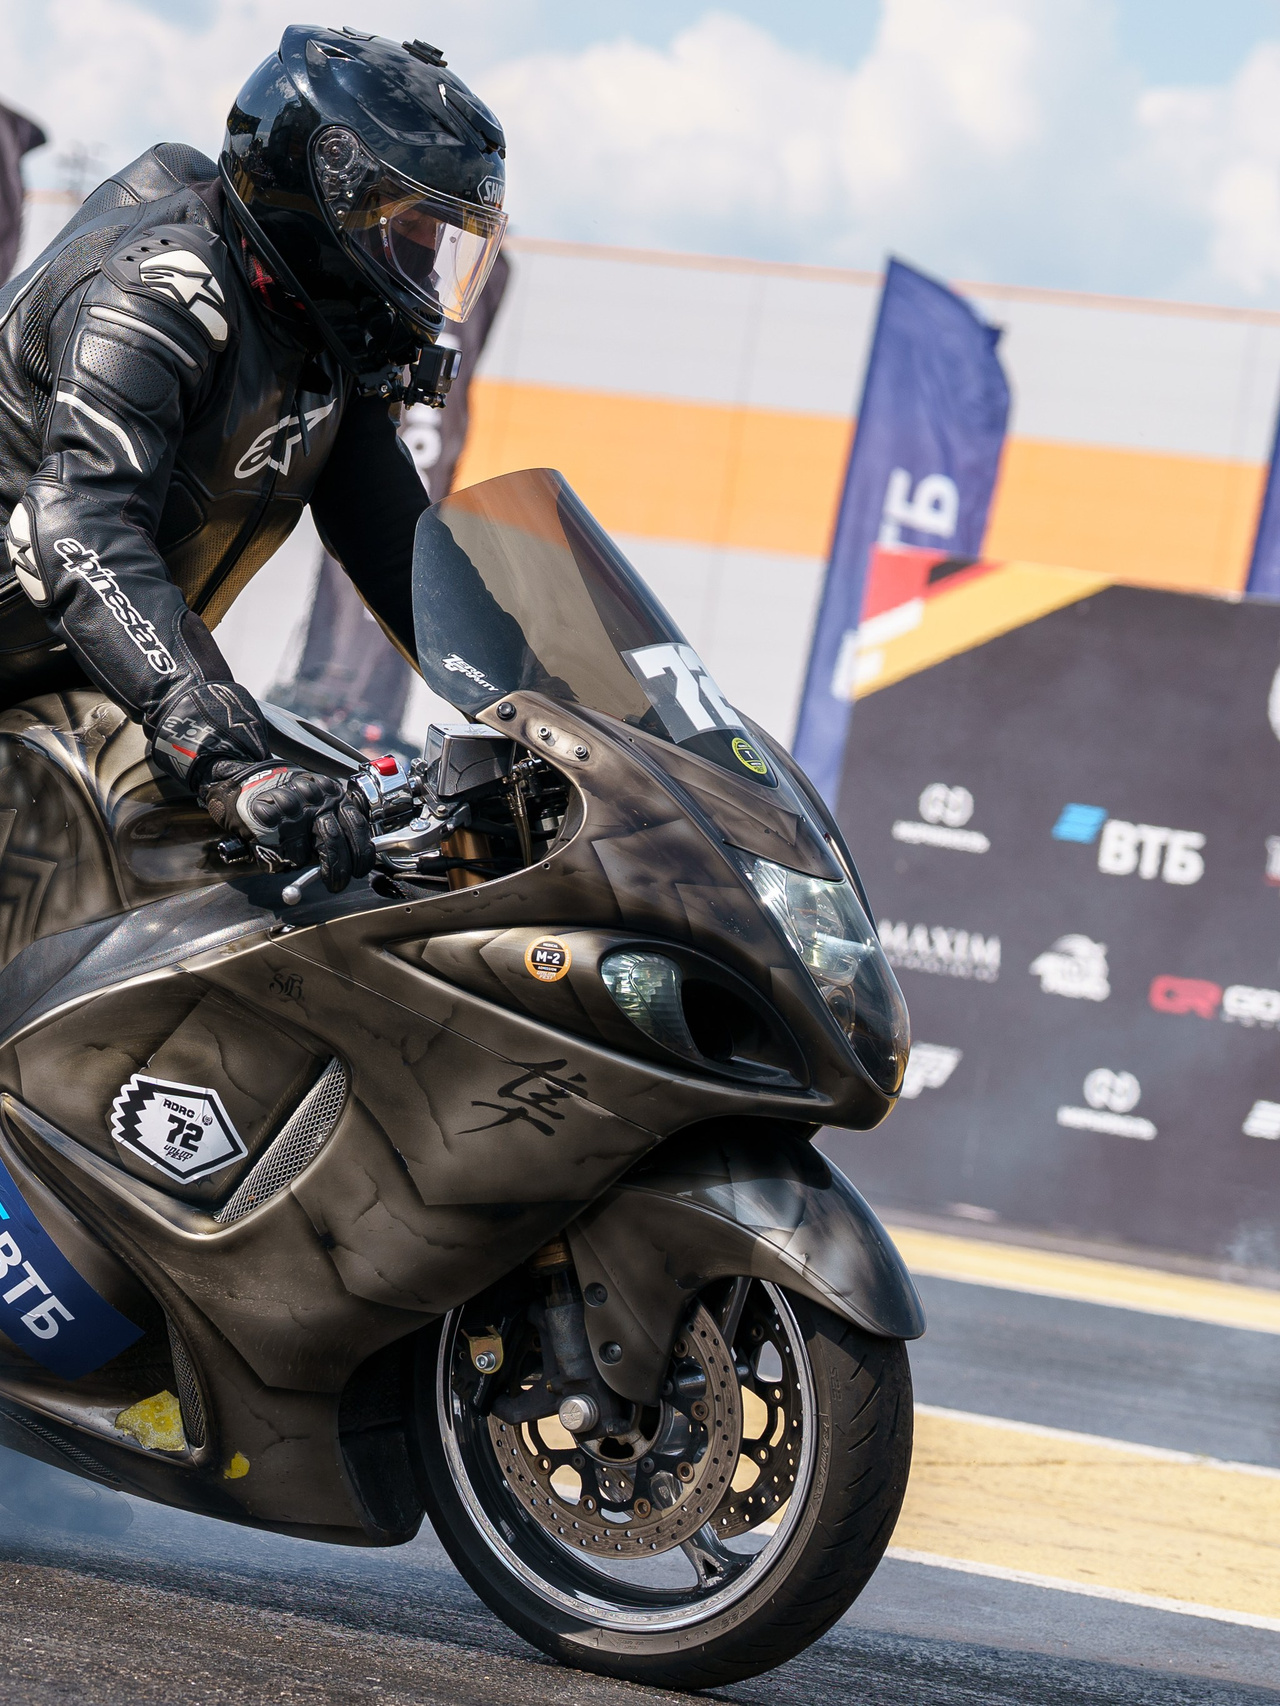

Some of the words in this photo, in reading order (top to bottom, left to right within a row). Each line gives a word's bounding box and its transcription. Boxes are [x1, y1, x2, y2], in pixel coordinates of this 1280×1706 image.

[483, 180, 505, 205] SHO
[54, 538, 177, 675] alpinestars
[1097, 818, 1207, 886] ВТБ
[536, 950, 561, 964] M-2
[877, 919, 1001, 966] MAXIM
[163, 1098, 195, 1119] RDRC
[166, 1113, 204, 1152] 72
